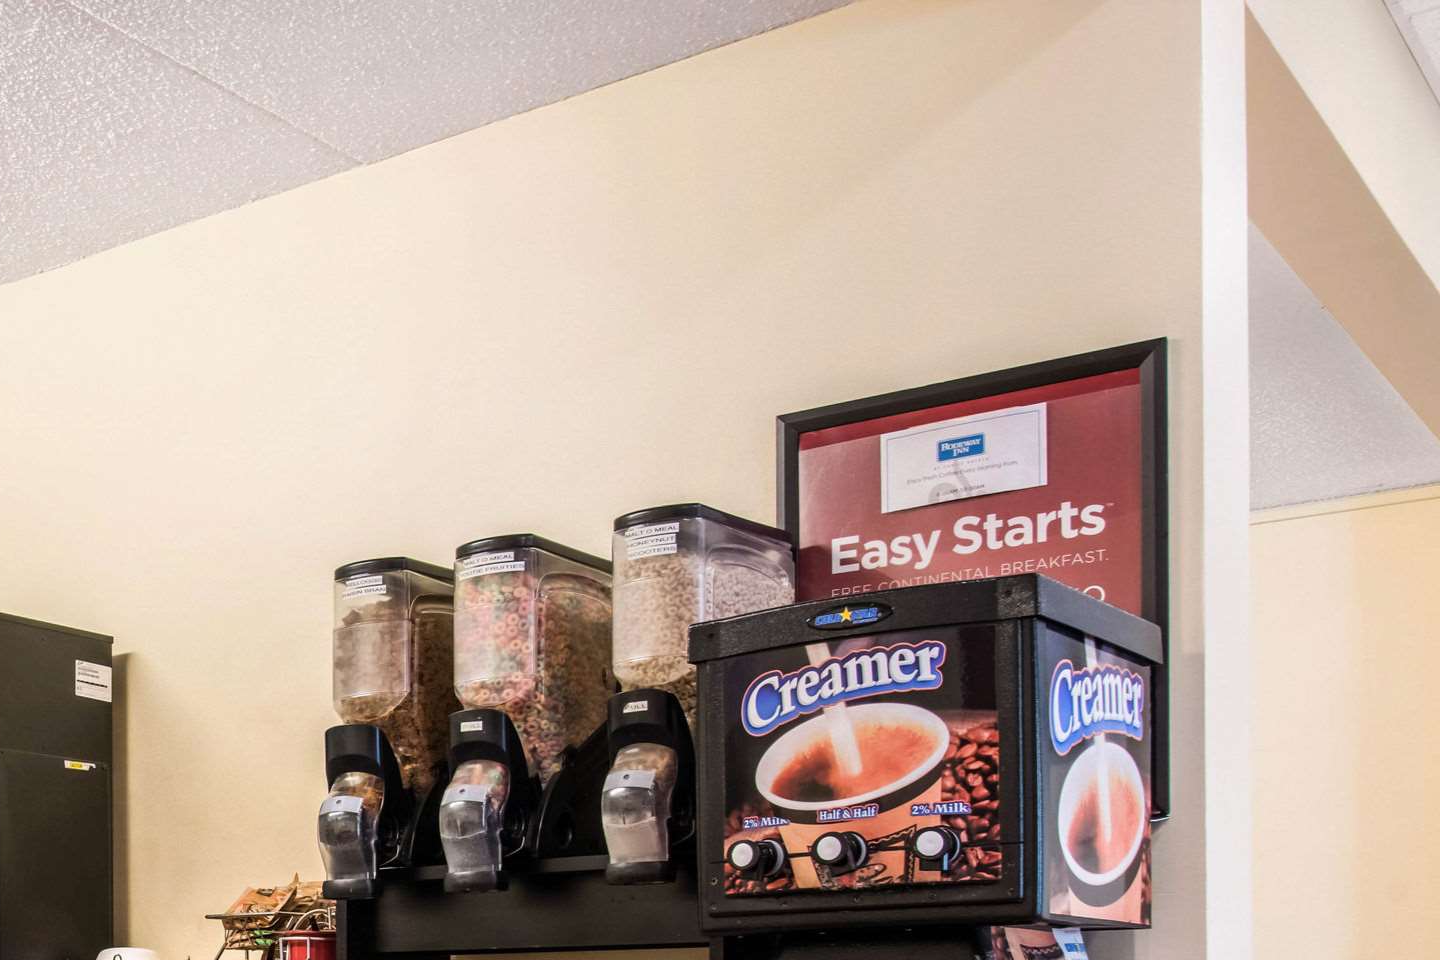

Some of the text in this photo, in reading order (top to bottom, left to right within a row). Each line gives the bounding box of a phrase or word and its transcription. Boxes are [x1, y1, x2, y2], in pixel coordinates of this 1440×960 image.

[654, 524, 678, 532] MEAL
[831, 500, 1107, 574] Easy Starts
[1000, 548, 1108, 575] BREAKFAST.
[747, 646, 940, 728] Creamer
[1053, 669, 1142, 742] Creamer
[819, 806, 878, 821] Half & Half
[912, 803, 969, 816] 2% Milk
[743, 817, 788, 828] 2% Milk
